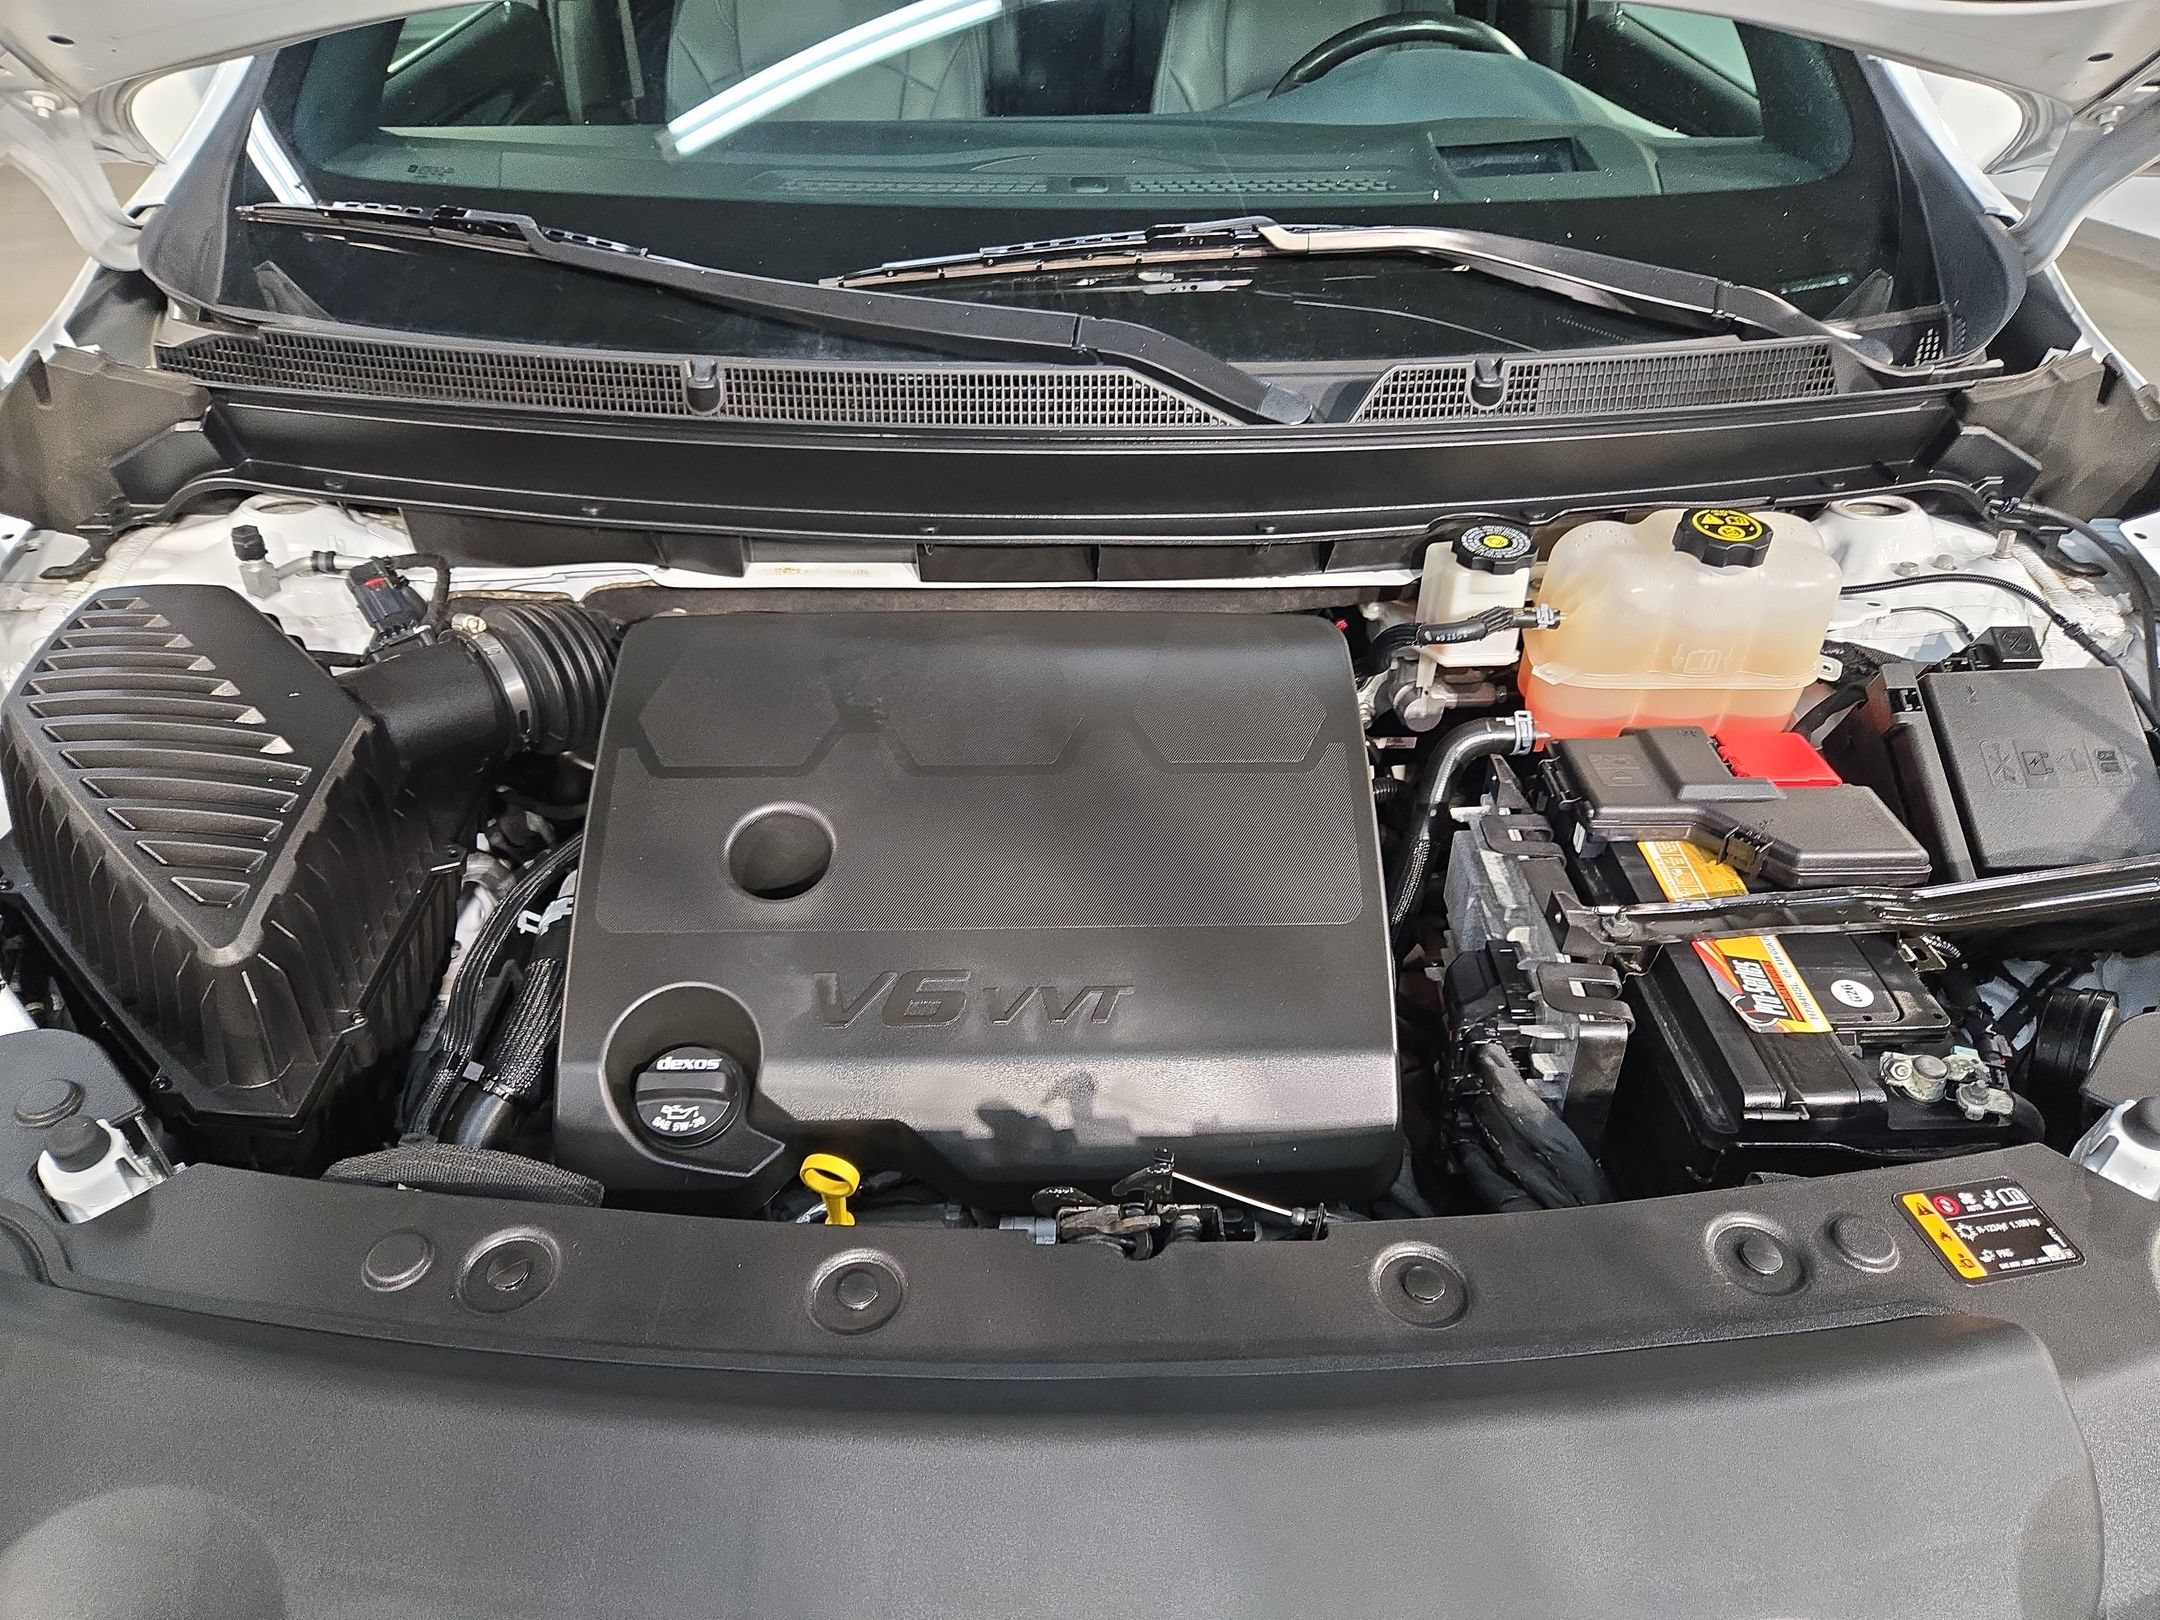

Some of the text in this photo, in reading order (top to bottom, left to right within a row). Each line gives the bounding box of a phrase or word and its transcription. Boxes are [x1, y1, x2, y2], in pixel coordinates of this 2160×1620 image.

[813, 970, 1135, 1029] V6 VVT
[1732, 959, 1788, 1016] Pro-Series
[656, 1056, 723, 1071] dexos
[652, 1116, 707, 1132] SAE 5W-30
